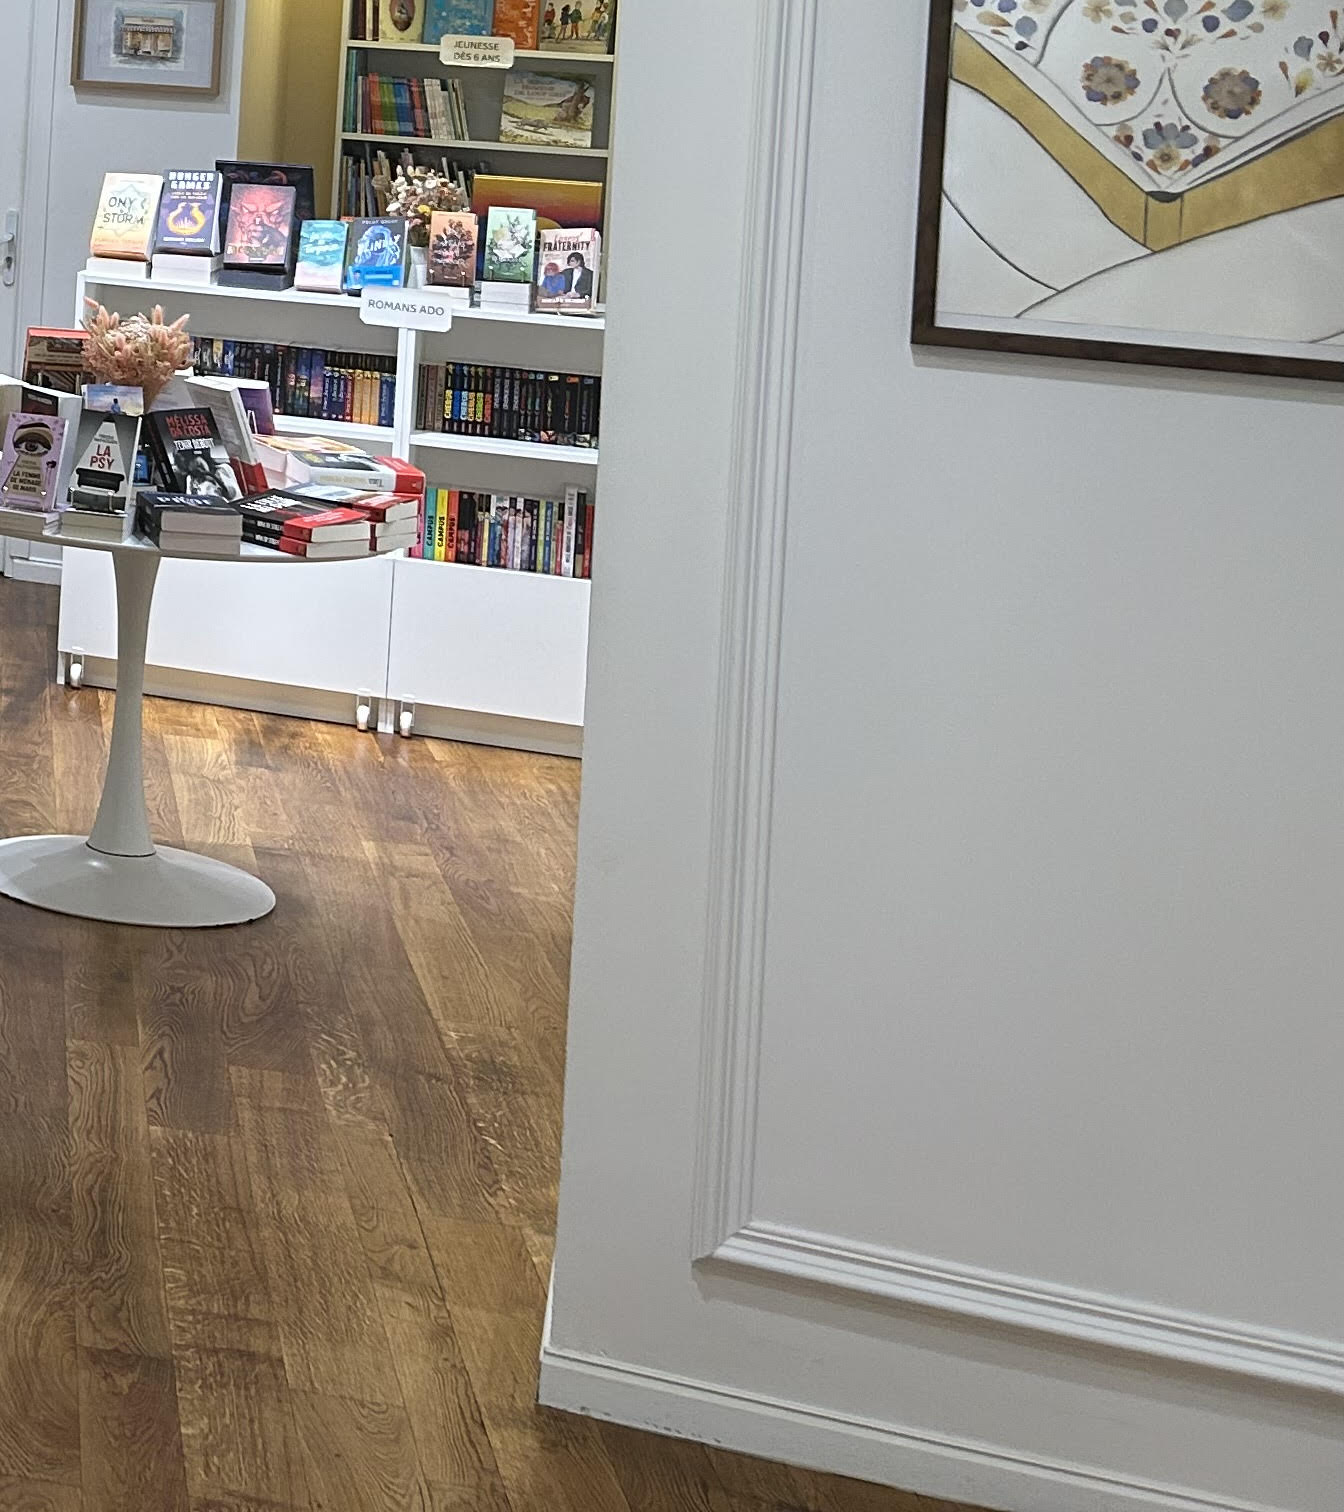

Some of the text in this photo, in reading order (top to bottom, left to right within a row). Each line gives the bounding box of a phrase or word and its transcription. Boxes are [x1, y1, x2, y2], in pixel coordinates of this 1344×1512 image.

[453, 40, 500, 51] JEUNESSE
[368, 299, 445, 317] ROMANS ADO
[96, 443, 112, 458] LA
[89, 455, 115, 471] PSY
[425, 515, 435, 547] CAMPUS
[437, 516, 446, 548] CAMPUS
[447, 516, 457, 549] CAMPUS
